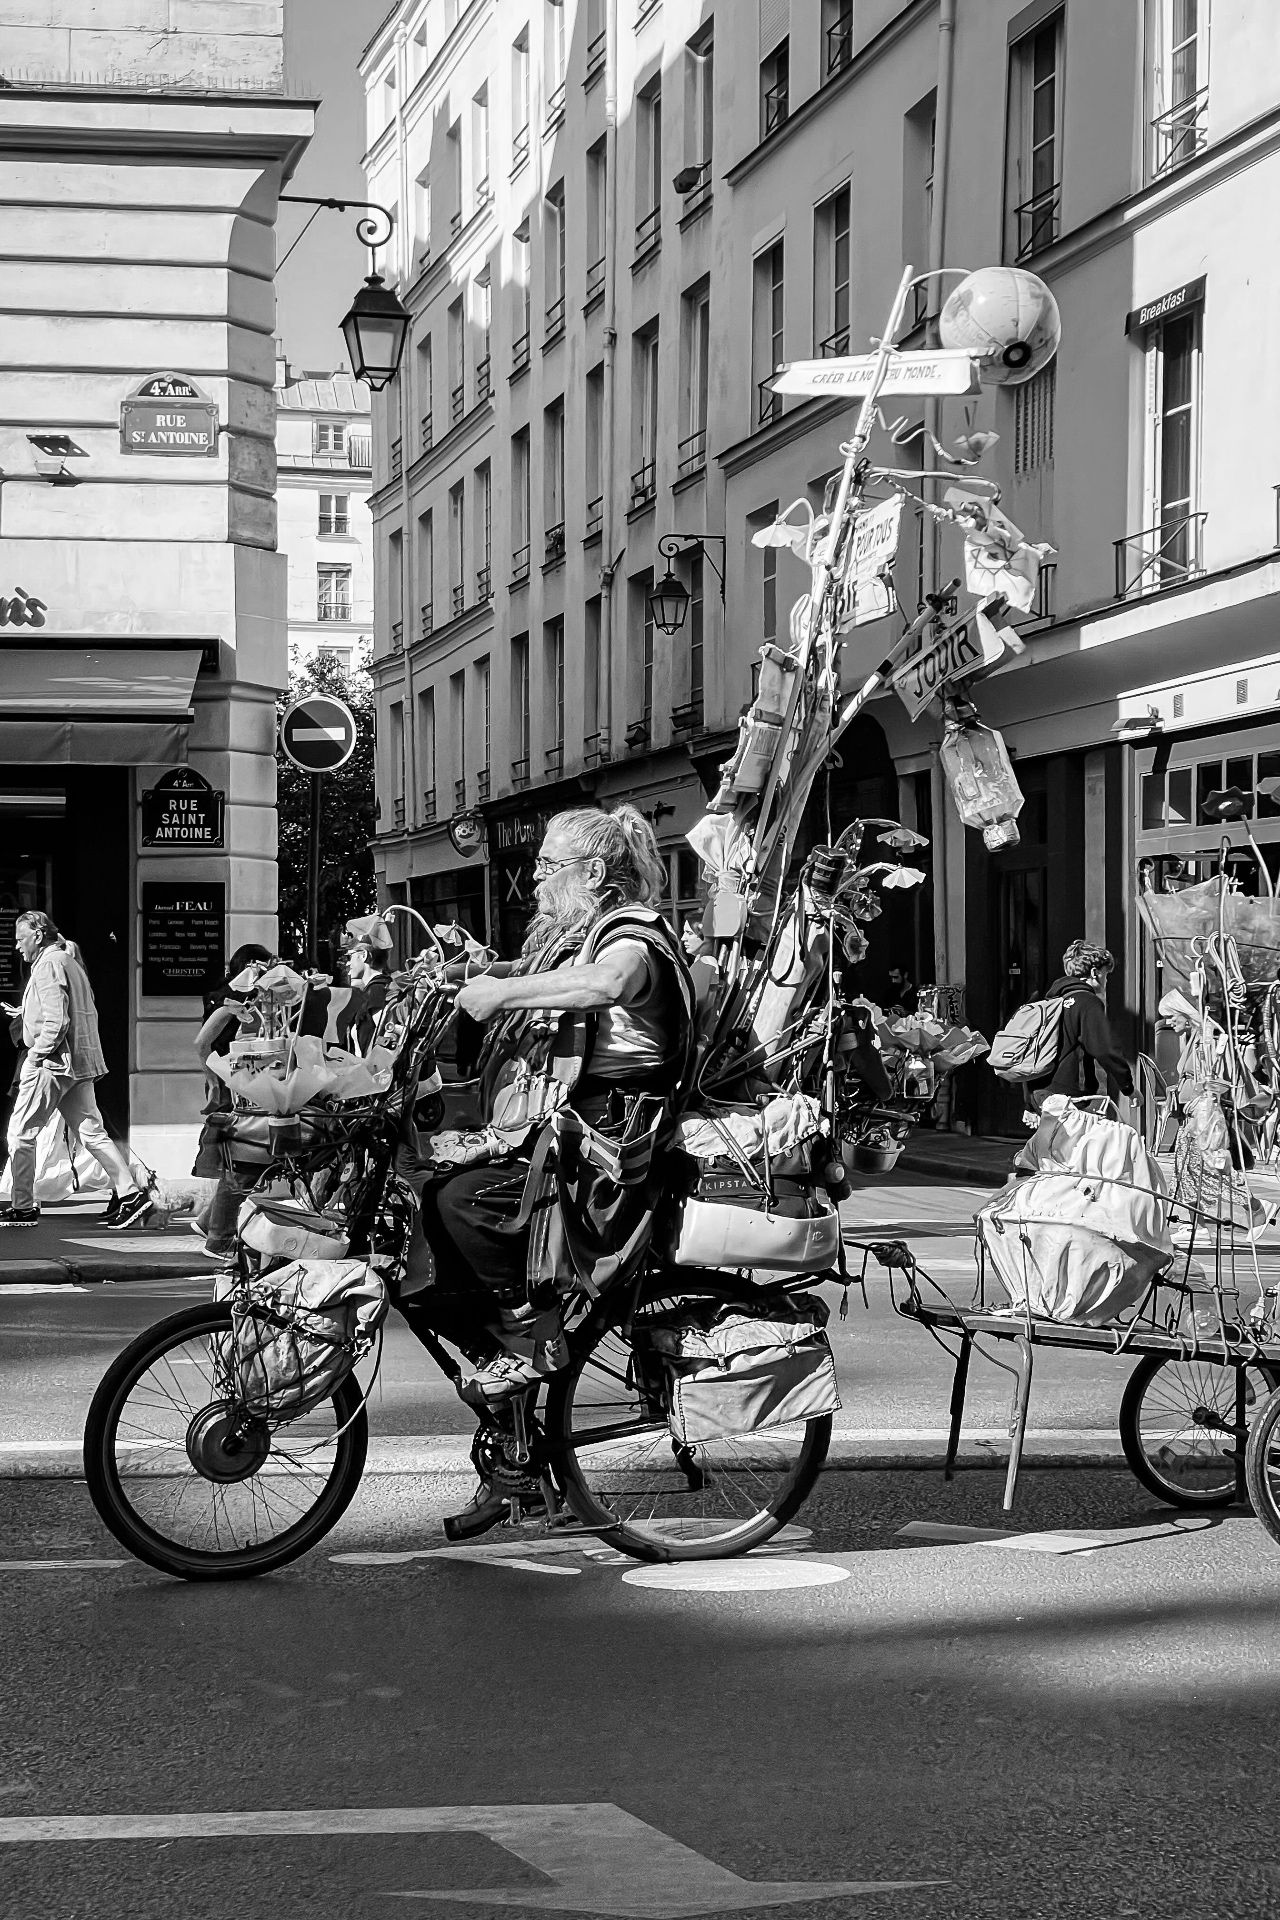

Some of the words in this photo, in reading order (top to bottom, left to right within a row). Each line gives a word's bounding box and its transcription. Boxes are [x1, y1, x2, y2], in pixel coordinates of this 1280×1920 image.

[1139, 288, 1186, 325] Breakfast
[156, 414, 187, 427] RUE
[147, 431, 209, 445] ANTOINE
[912, 623, 981, 699] JOUIR
[169, 799, 198, 811] RUE
[161, 813, 206, 825] SAINT
[155, 827, 212, 839] ANTOINE
[497, 821, 512, 849] The
[514, 817, 535, 845] Pure
[705, 1180, 748, 1190] KIPSTA
